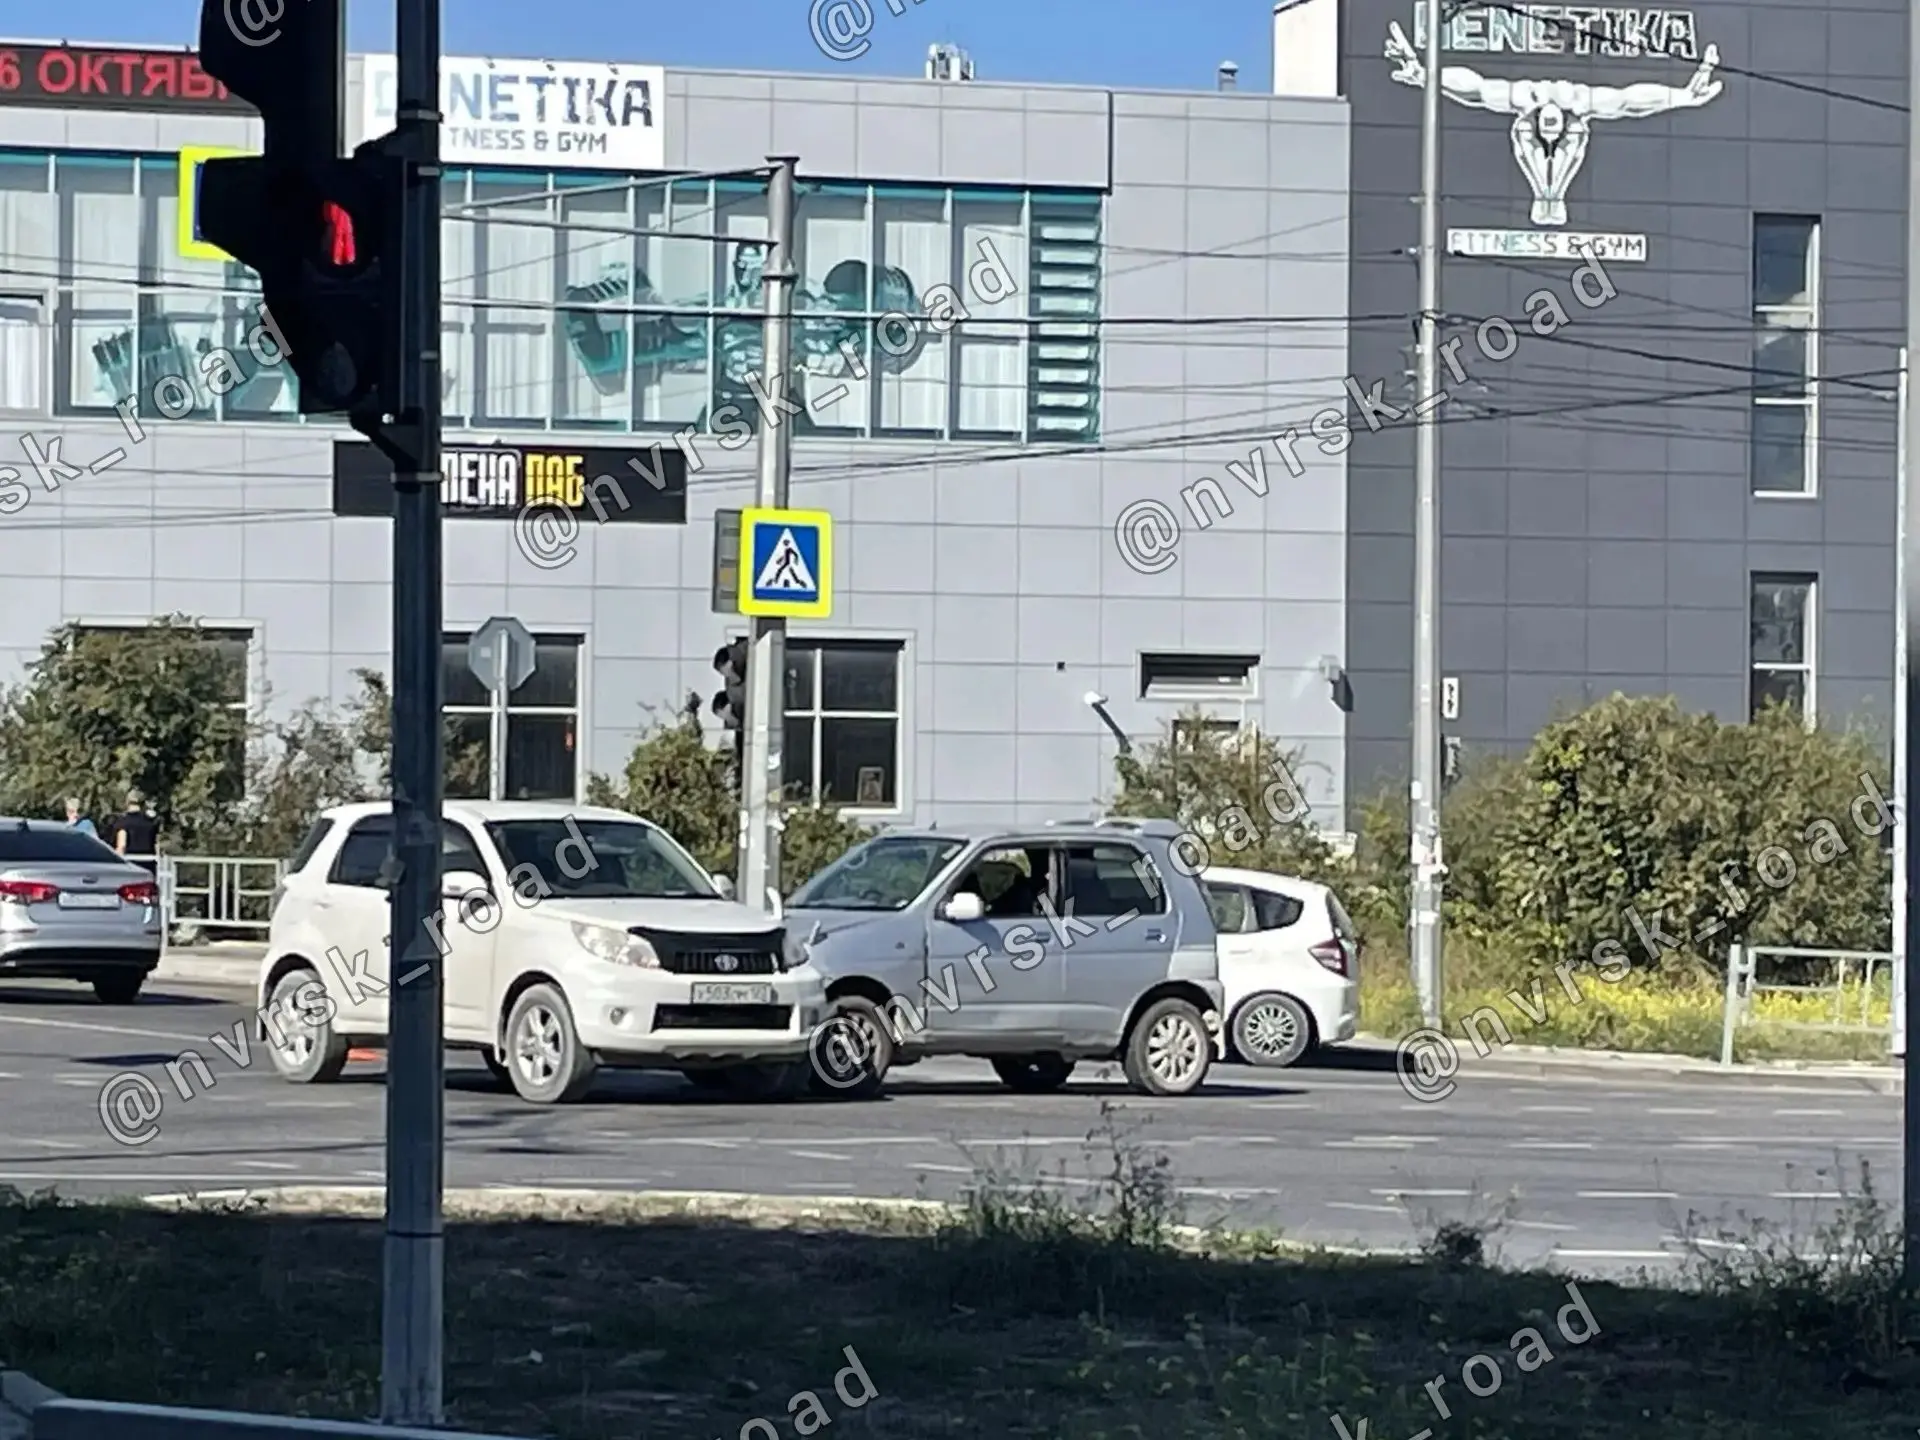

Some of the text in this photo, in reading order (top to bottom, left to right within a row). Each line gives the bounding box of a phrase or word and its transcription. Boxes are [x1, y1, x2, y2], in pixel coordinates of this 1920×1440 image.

[38, 51, 229, 100] ОКТЯБ
[449, 127, 607, 154] TNESS & GYM
[1450, 231, 1643, 258] FITNESS & GYM
[525, 453, 584, 507] ПАБ
